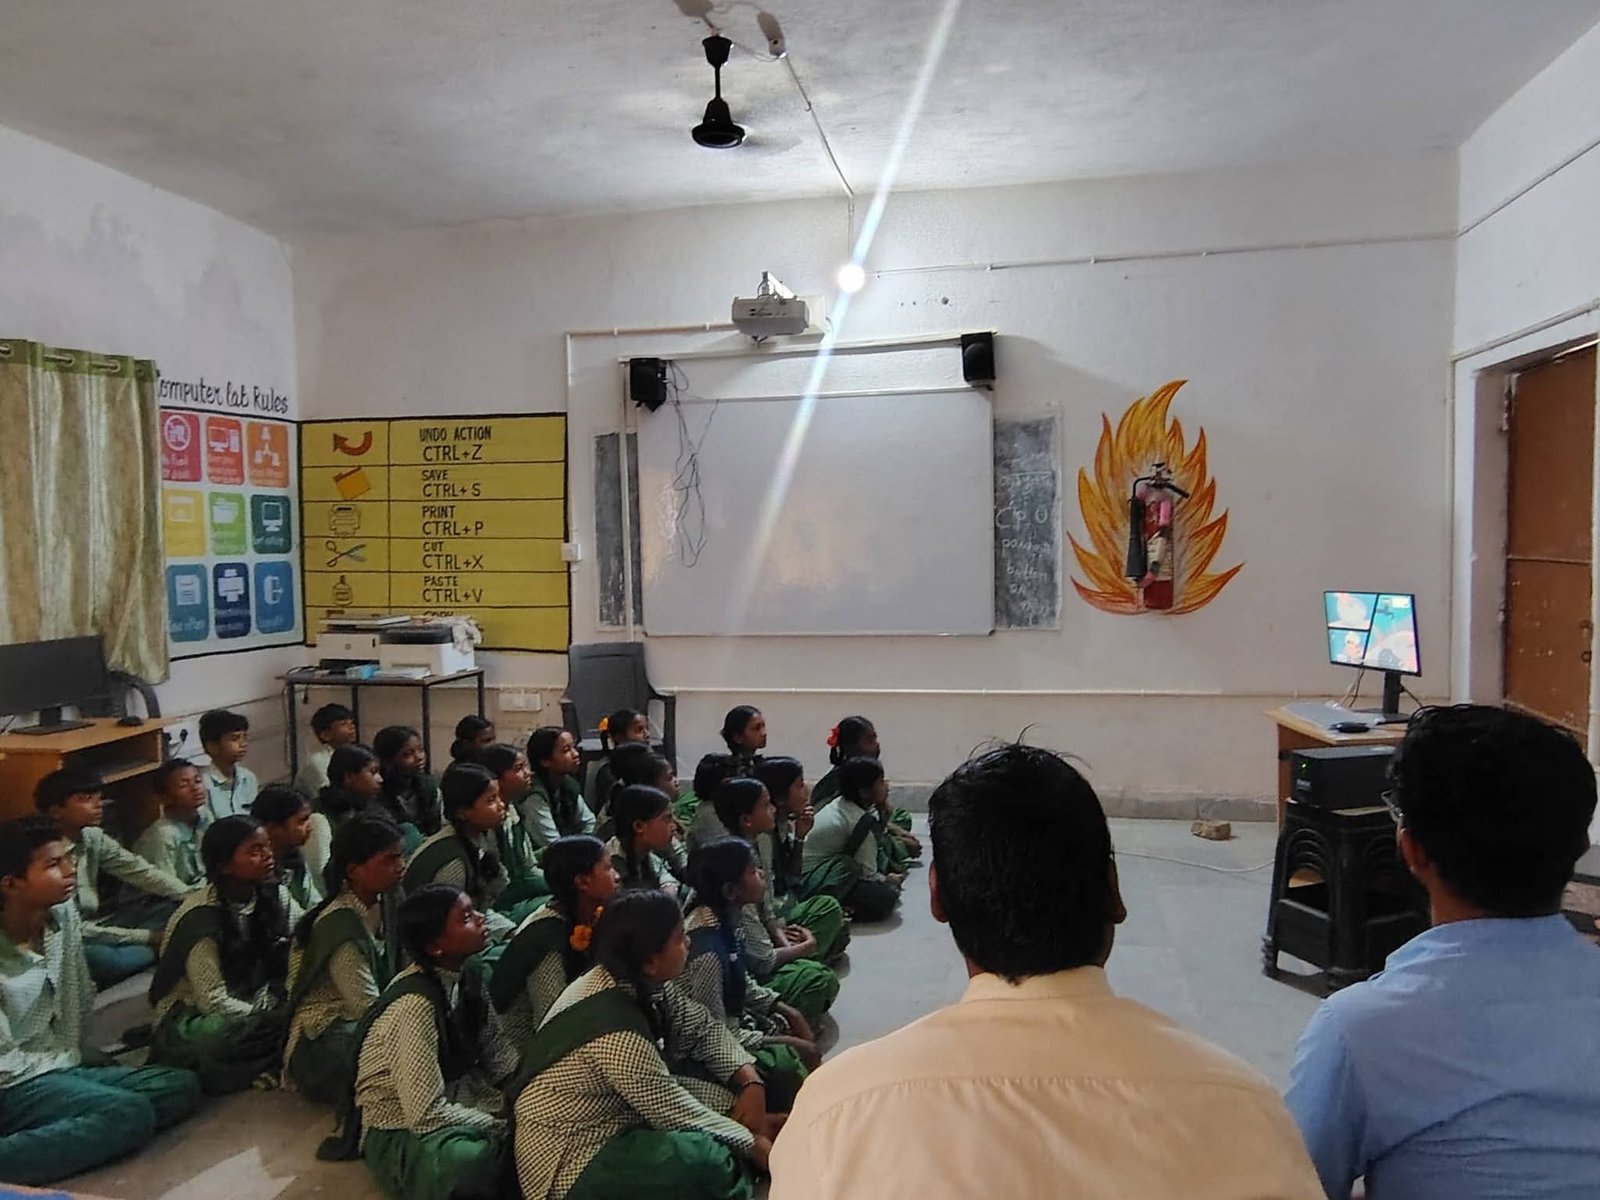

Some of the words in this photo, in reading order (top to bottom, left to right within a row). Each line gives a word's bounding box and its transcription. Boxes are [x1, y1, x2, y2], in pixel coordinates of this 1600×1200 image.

[156, 369, 223, 406] omputer
[253, 385, 288, 414] Rules
[420, 427, 447, 442] UNDO
[454, 426, 491, 441] ACTION
[423, 444, 482, 461] CTRL+Z
[421, 469, 448, 481] SAVE
[422, 505, 456, 518] PRINT
[423, 541, 444, 552] CUT
[423, 576, 458, 587] PASTE
[422, 588, 483, 603] CTRL+V
